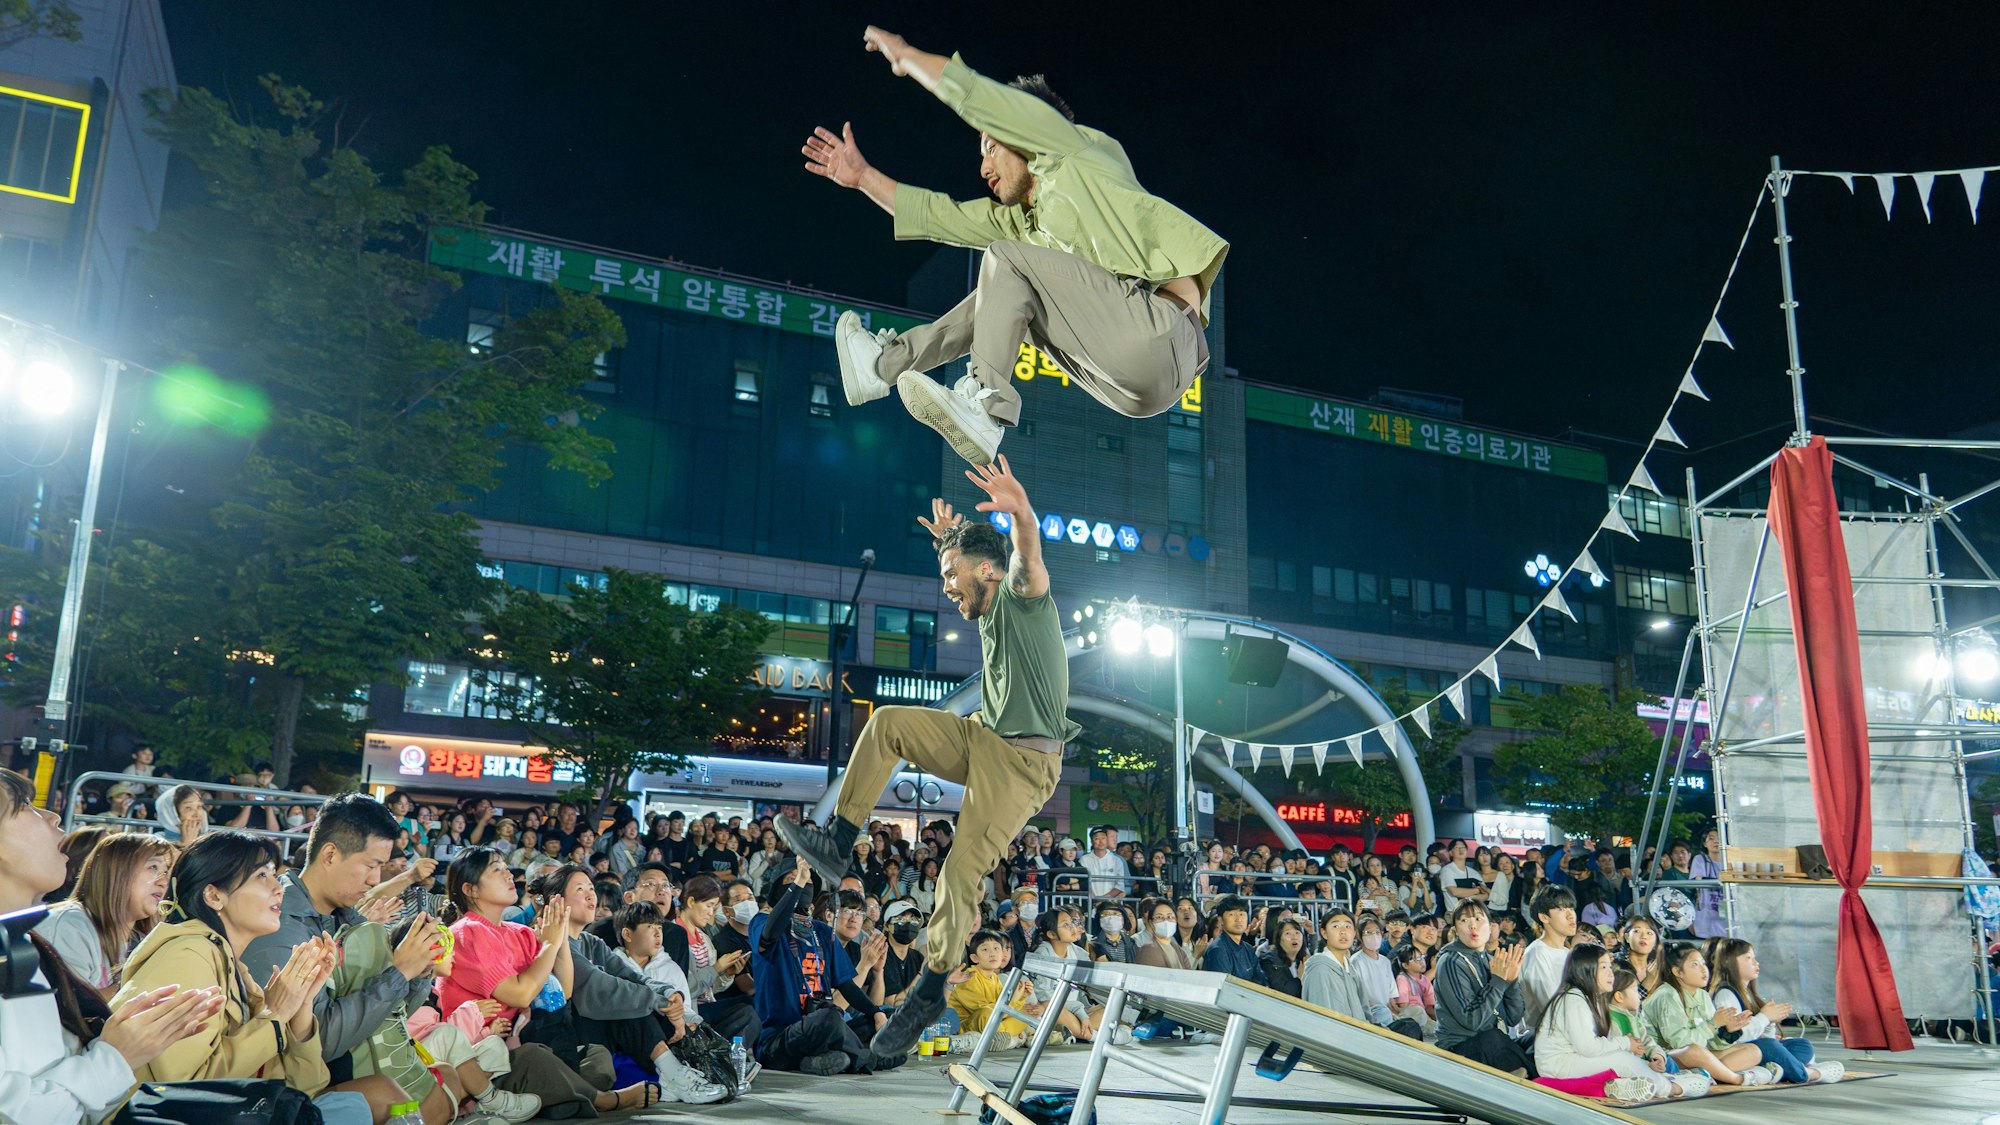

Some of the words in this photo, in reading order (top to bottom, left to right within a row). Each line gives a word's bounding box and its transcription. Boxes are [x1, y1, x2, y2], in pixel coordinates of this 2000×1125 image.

[487, 240, 566, 283] 재활
[589, 258, 660, 302] 투석
[682, 278, 787, 326] 암통합
[1310, 402, 1355, 436] 산재
[1367, 413, 1413, 446] 재활
[1420, 423, 1551, 472] 인증의료기관
